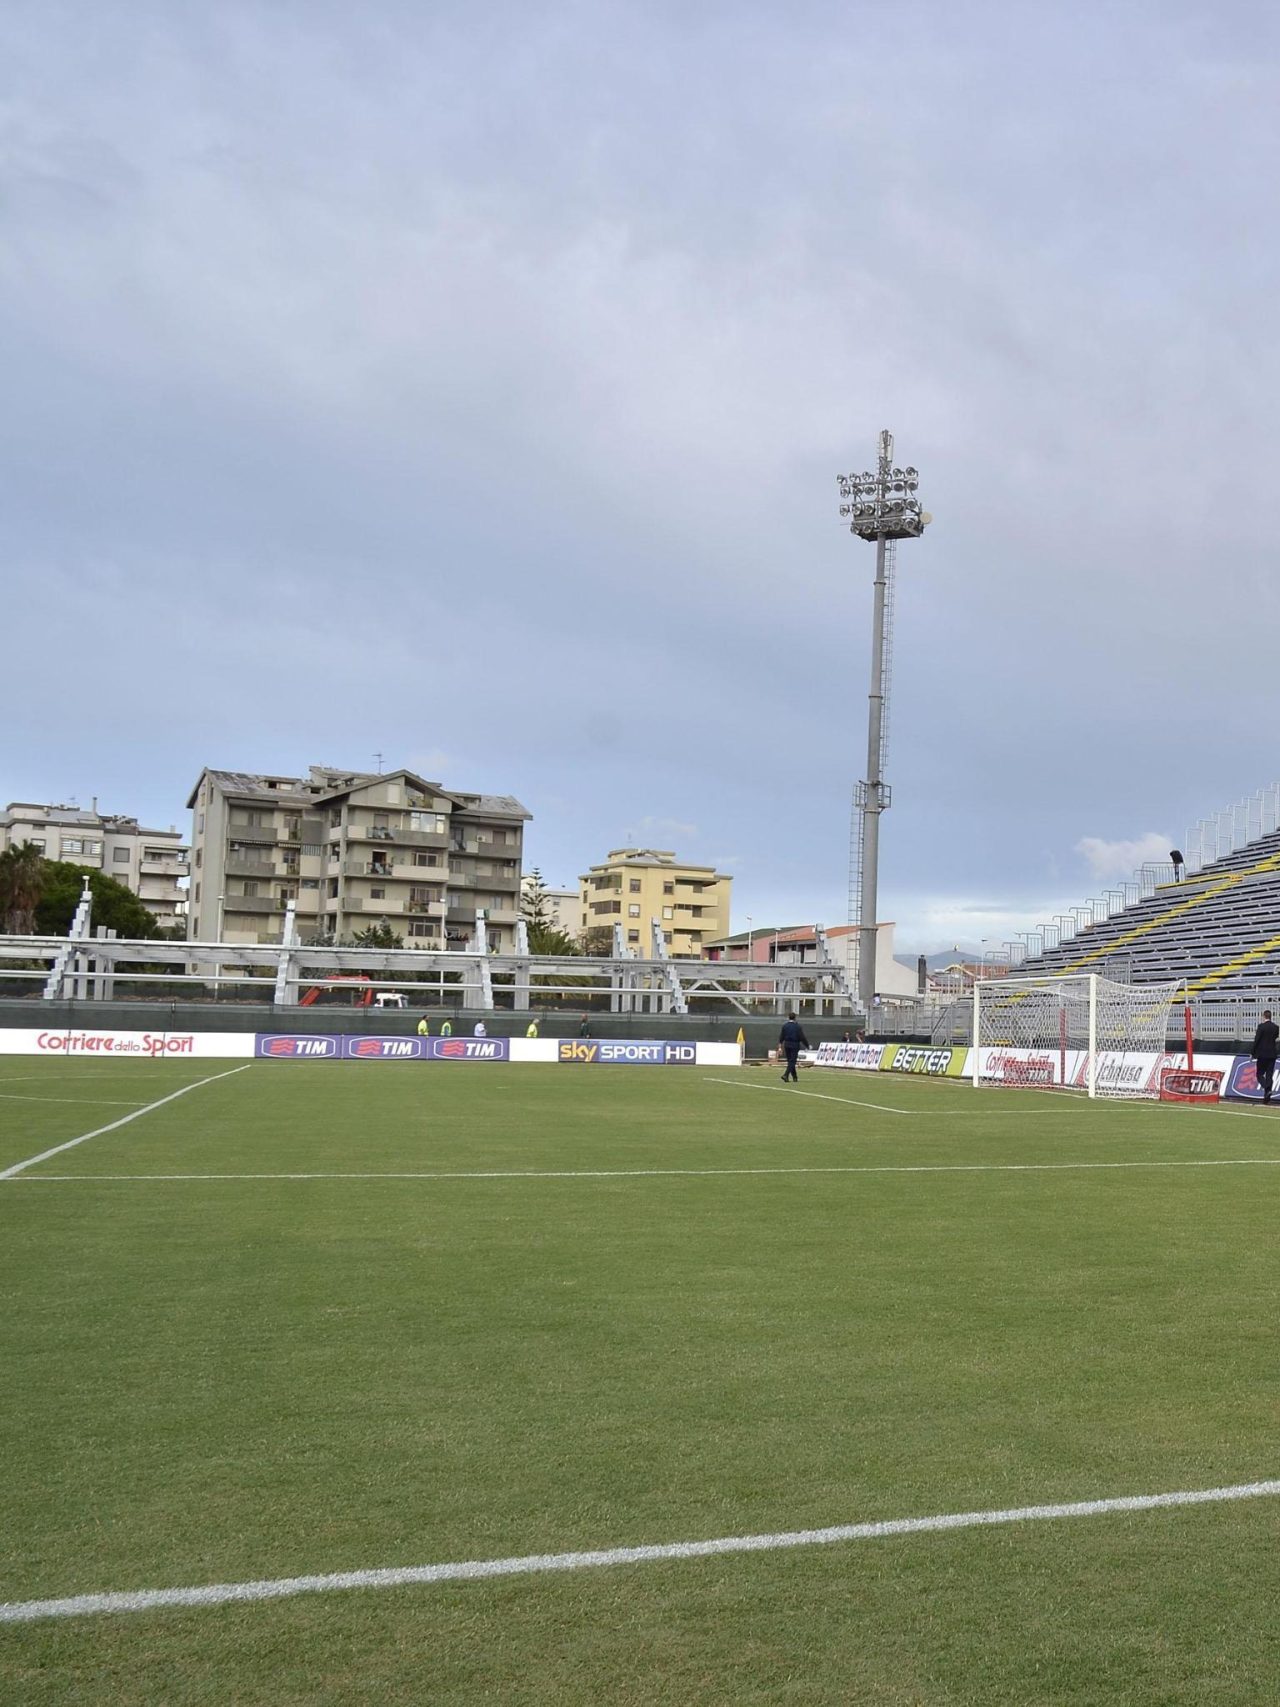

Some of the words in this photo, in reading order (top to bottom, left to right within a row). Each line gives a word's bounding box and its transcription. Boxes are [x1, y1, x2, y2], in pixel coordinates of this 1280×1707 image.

[37, 1032, 114, 1051] Corriere
[114, 1040, 141, 1052] dello
[142, 1034, 194, 1057] Sport
[296, 1040, 328, 1055] TIM
[382, 1041, 413, 1056] TIM
[465, 1042, 496, 1057] TIM
[560, 1041, 597, 1062] sky
[600, 1045, 661, 1060] SPORT
[666, 1046, 695, 1060] HD
[892, 1046, 952, 1073] BETTER
[1190, 1079, 1214, 1092] TIM
